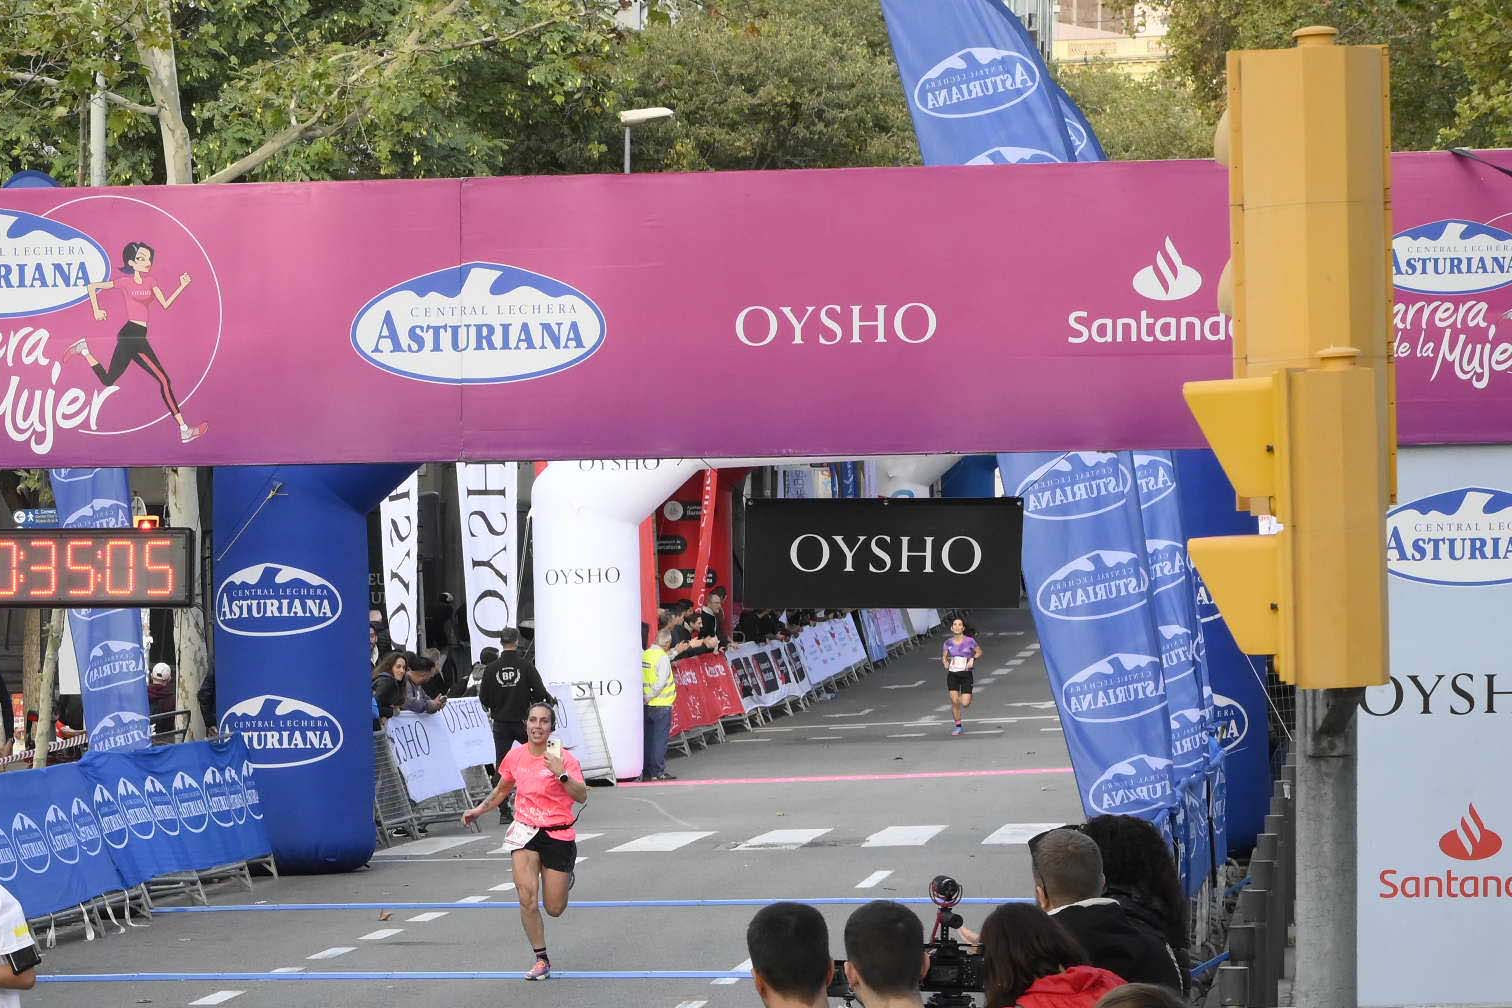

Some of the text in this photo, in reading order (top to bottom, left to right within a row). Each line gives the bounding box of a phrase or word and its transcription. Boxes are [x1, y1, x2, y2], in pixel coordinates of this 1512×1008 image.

[11, 246, 86, 257] LECHERA
[410, 303, 578, 318] CENTRAL LECHERA
[734, 302, 938, 346] OYSHO
[1393, 300, 1488, 329] arrera
[370, 309, 586, 355] ASTURIANA
[1067, 309, 1233, 344] Santand
[1417, 330, 1434, 357] la
[1430, 324, 1512, 389] Muje
[1414, 523, 1480, 532] CENTRAL
[790, 534, 982, 574] OYSHO
[1386, 526, 1512, 561] ASTURI
[545, 566, 621, 586] OYSHO
[220, 592, 333, 620] ASTURIANA
[232, 588, 328, 597] CENTRAL LECHERA
[1357, 672, 1512, 716] OYSH
[280, 719, 328, 727] LECHERA
[442, 701, 486, 734] OYSH
[1379, 869, 1512, 899] Santan
